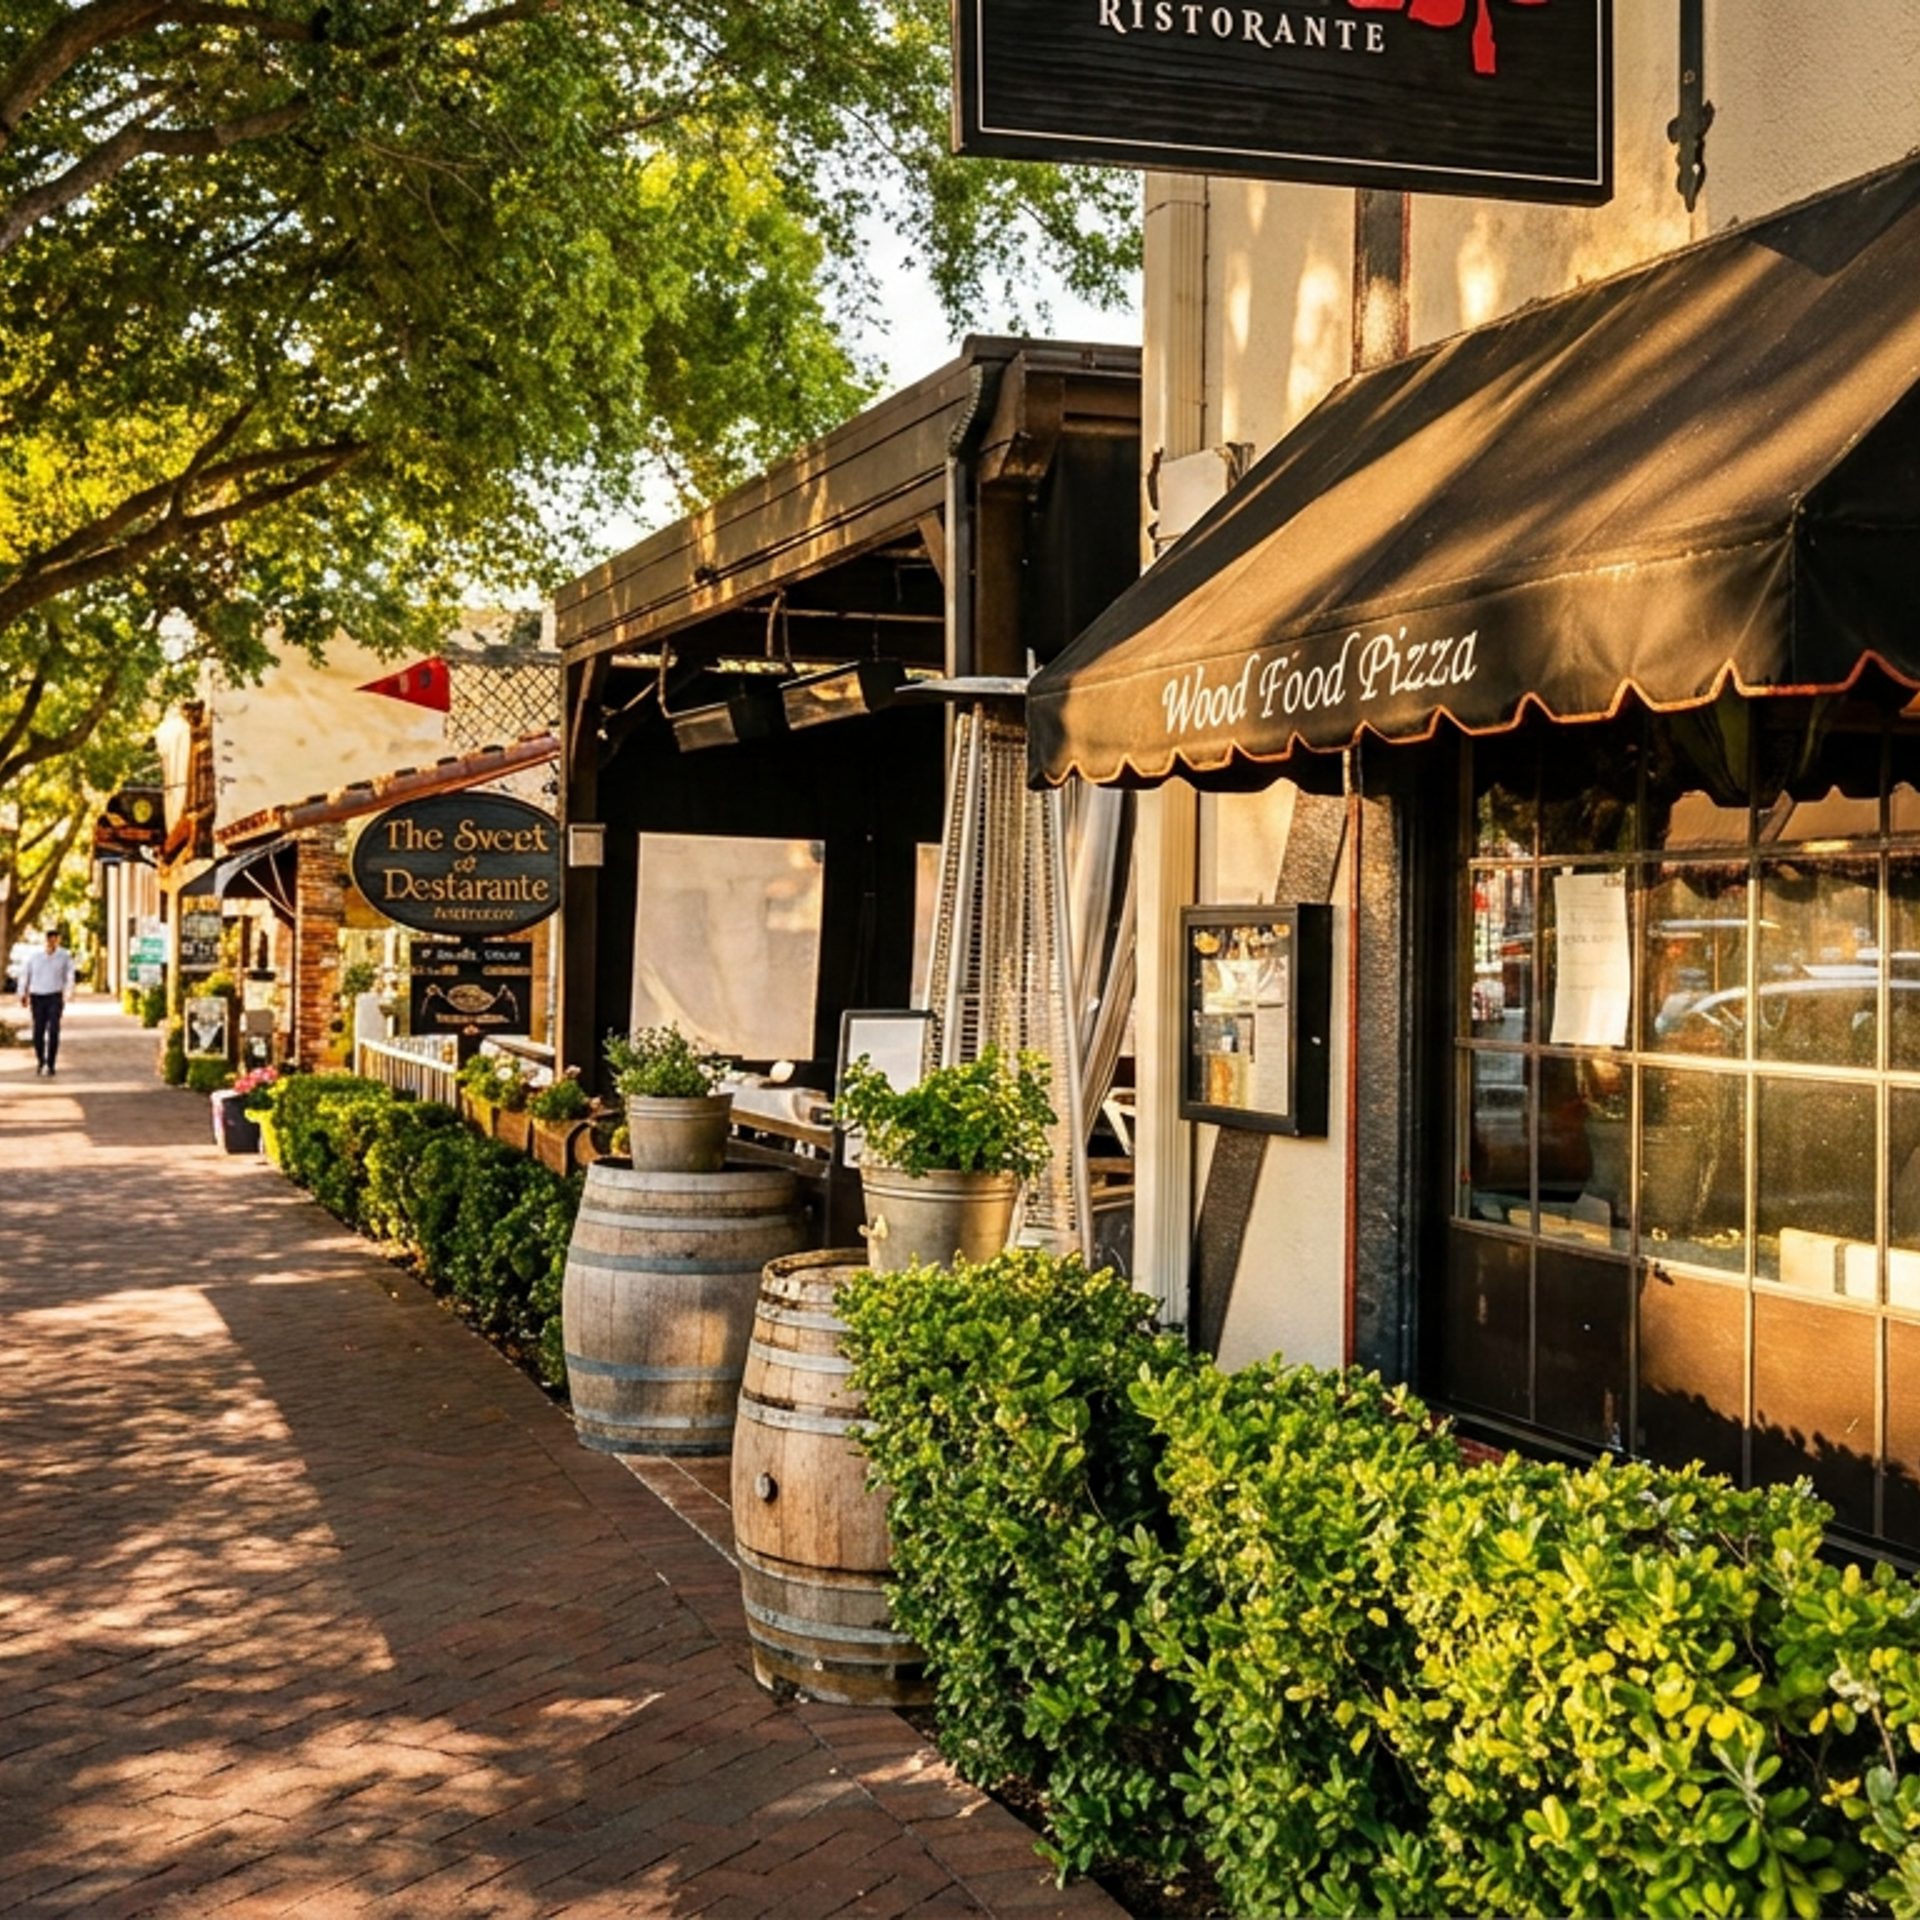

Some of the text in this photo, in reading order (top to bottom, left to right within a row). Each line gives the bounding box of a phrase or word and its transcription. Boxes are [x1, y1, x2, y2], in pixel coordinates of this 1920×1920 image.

[1099, 0, 1385, 52] RISTORANTE
[1161, 626, 1478, 734] Wood Food Pizza
[384, 819, 444, 850] The
[383, 868, 549, 901] Destarante
